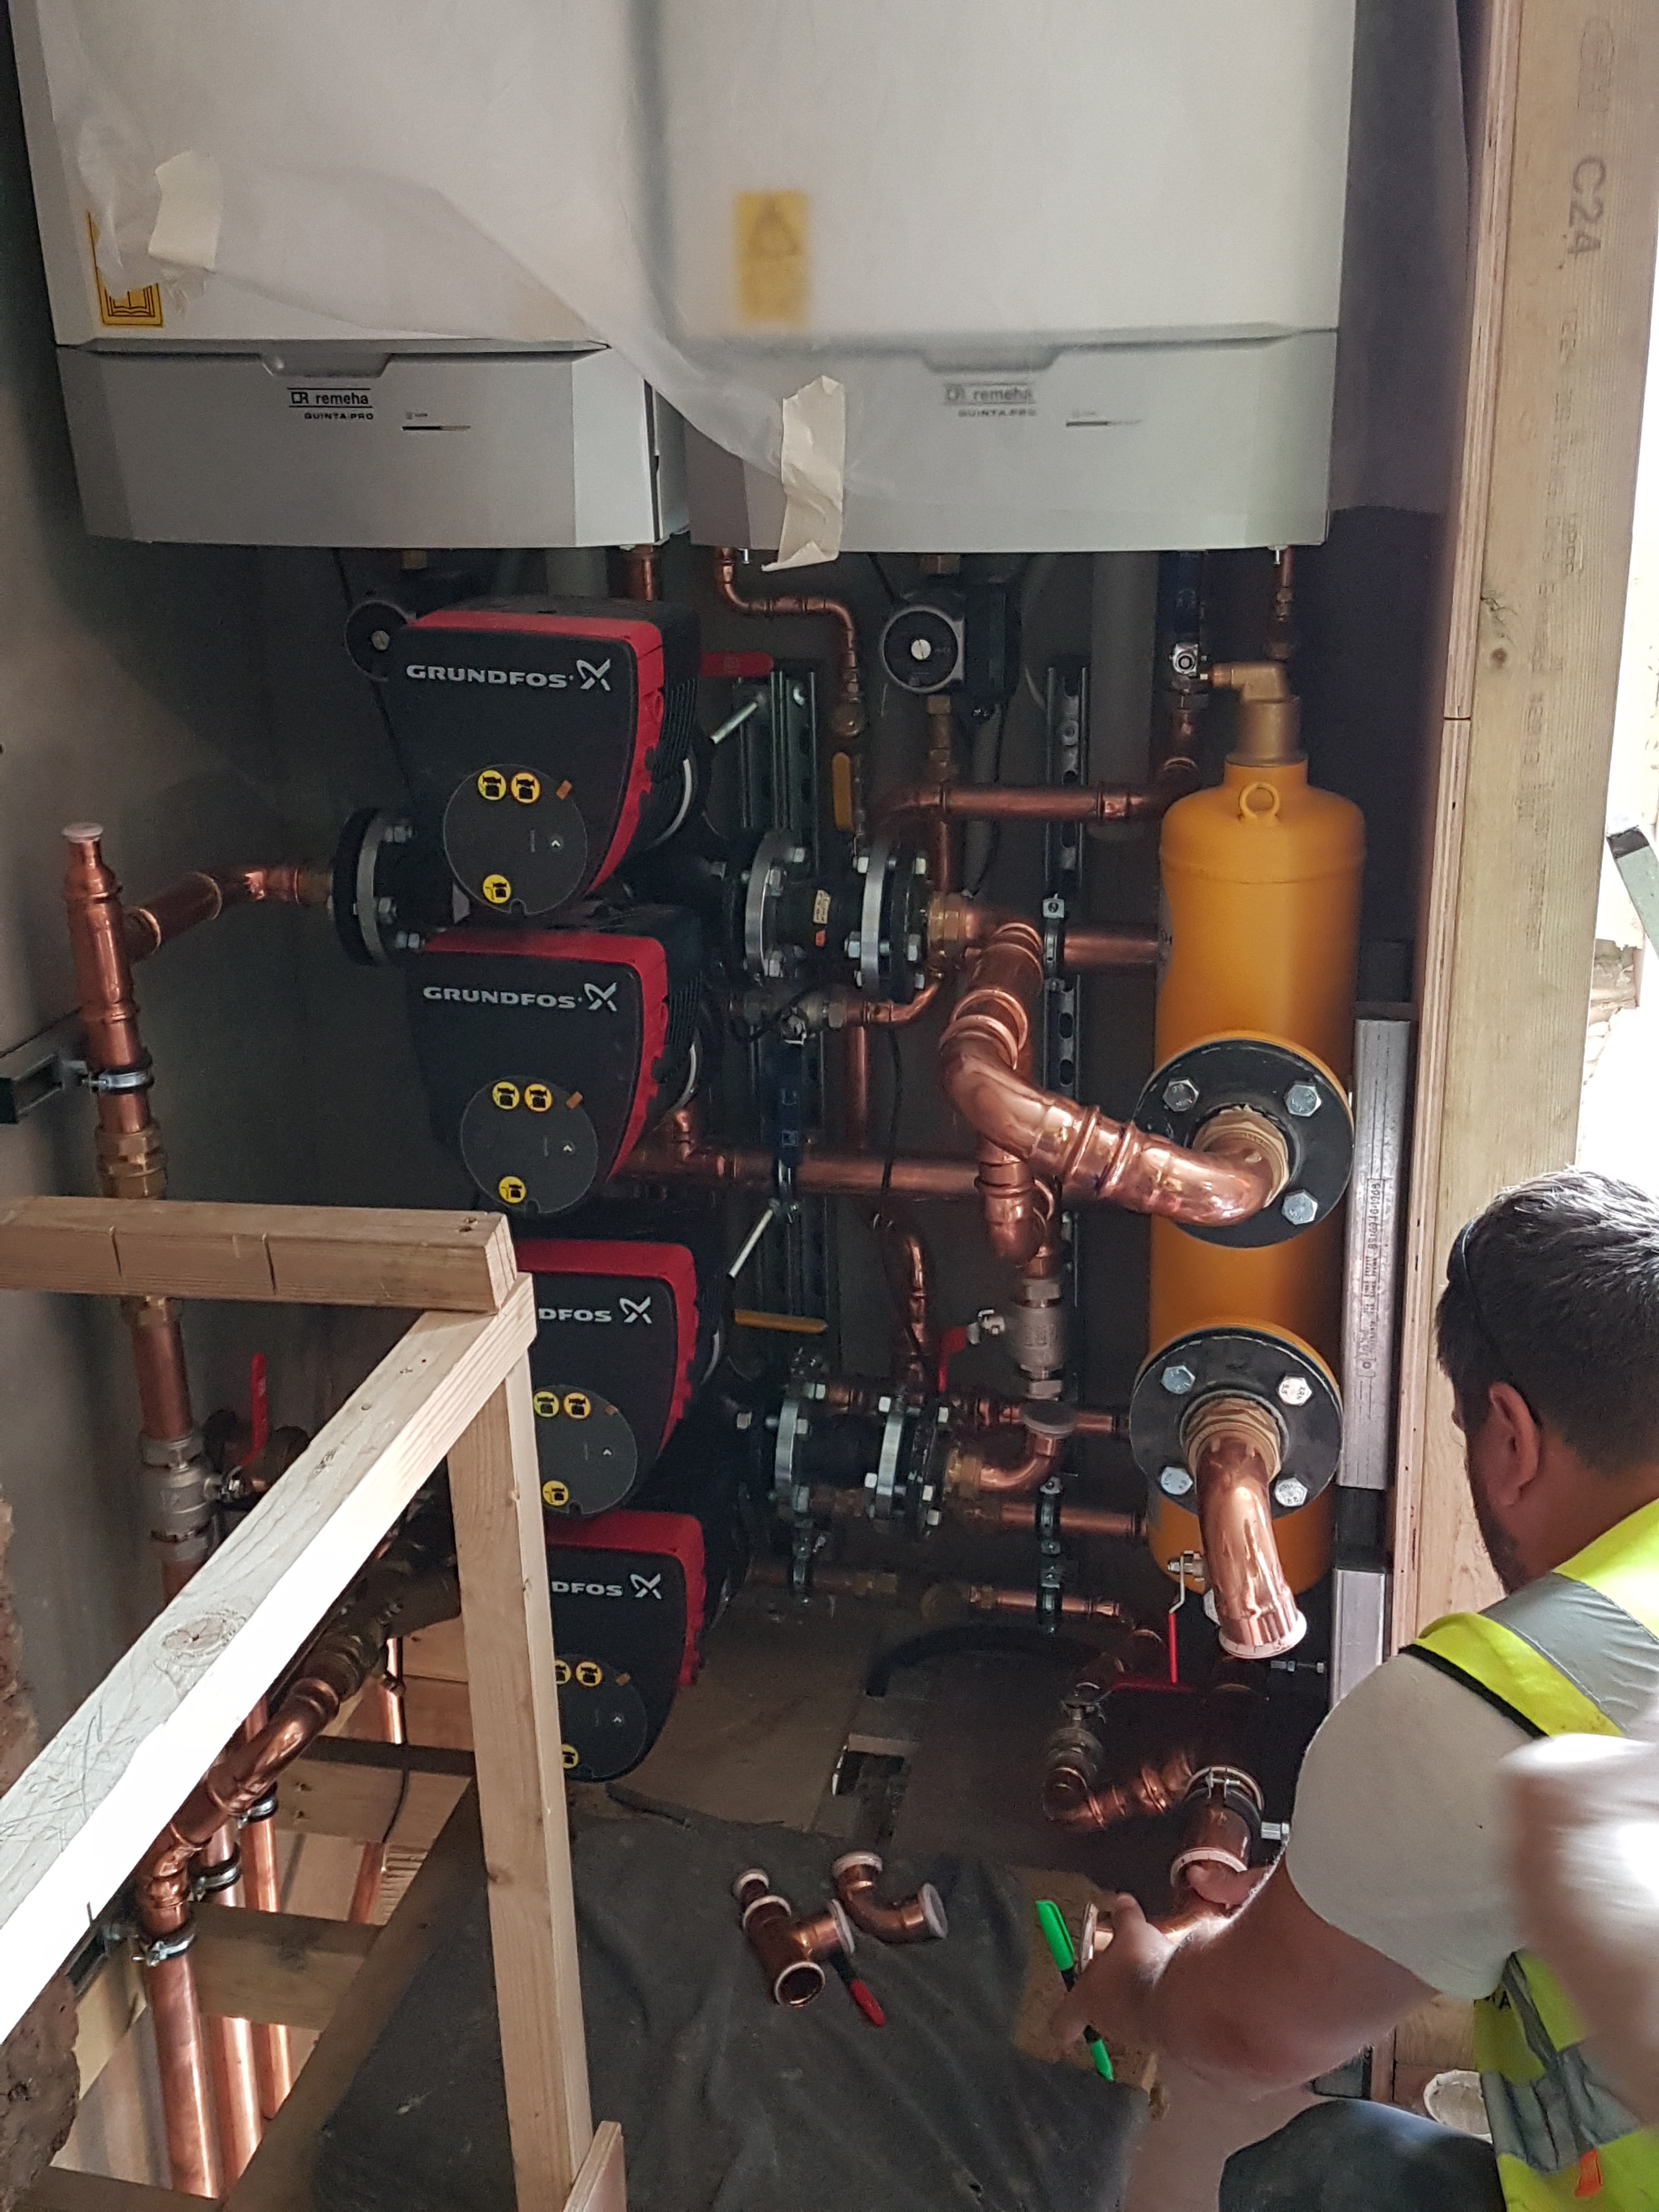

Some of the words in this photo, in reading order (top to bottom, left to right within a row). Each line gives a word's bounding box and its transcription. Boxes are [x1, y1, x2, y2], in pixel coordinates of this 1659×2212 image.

[1567, 157, 1606, 258] C24
[316, 392, 369, 405] remeha
[407, 665, 567, 688] GRUNDFOS
[424, 986, 575, 1008] GRUNDFOS
[538, 1307, 612, 1323] DFOS
[551, 1581, 624, 1596] DFOS
